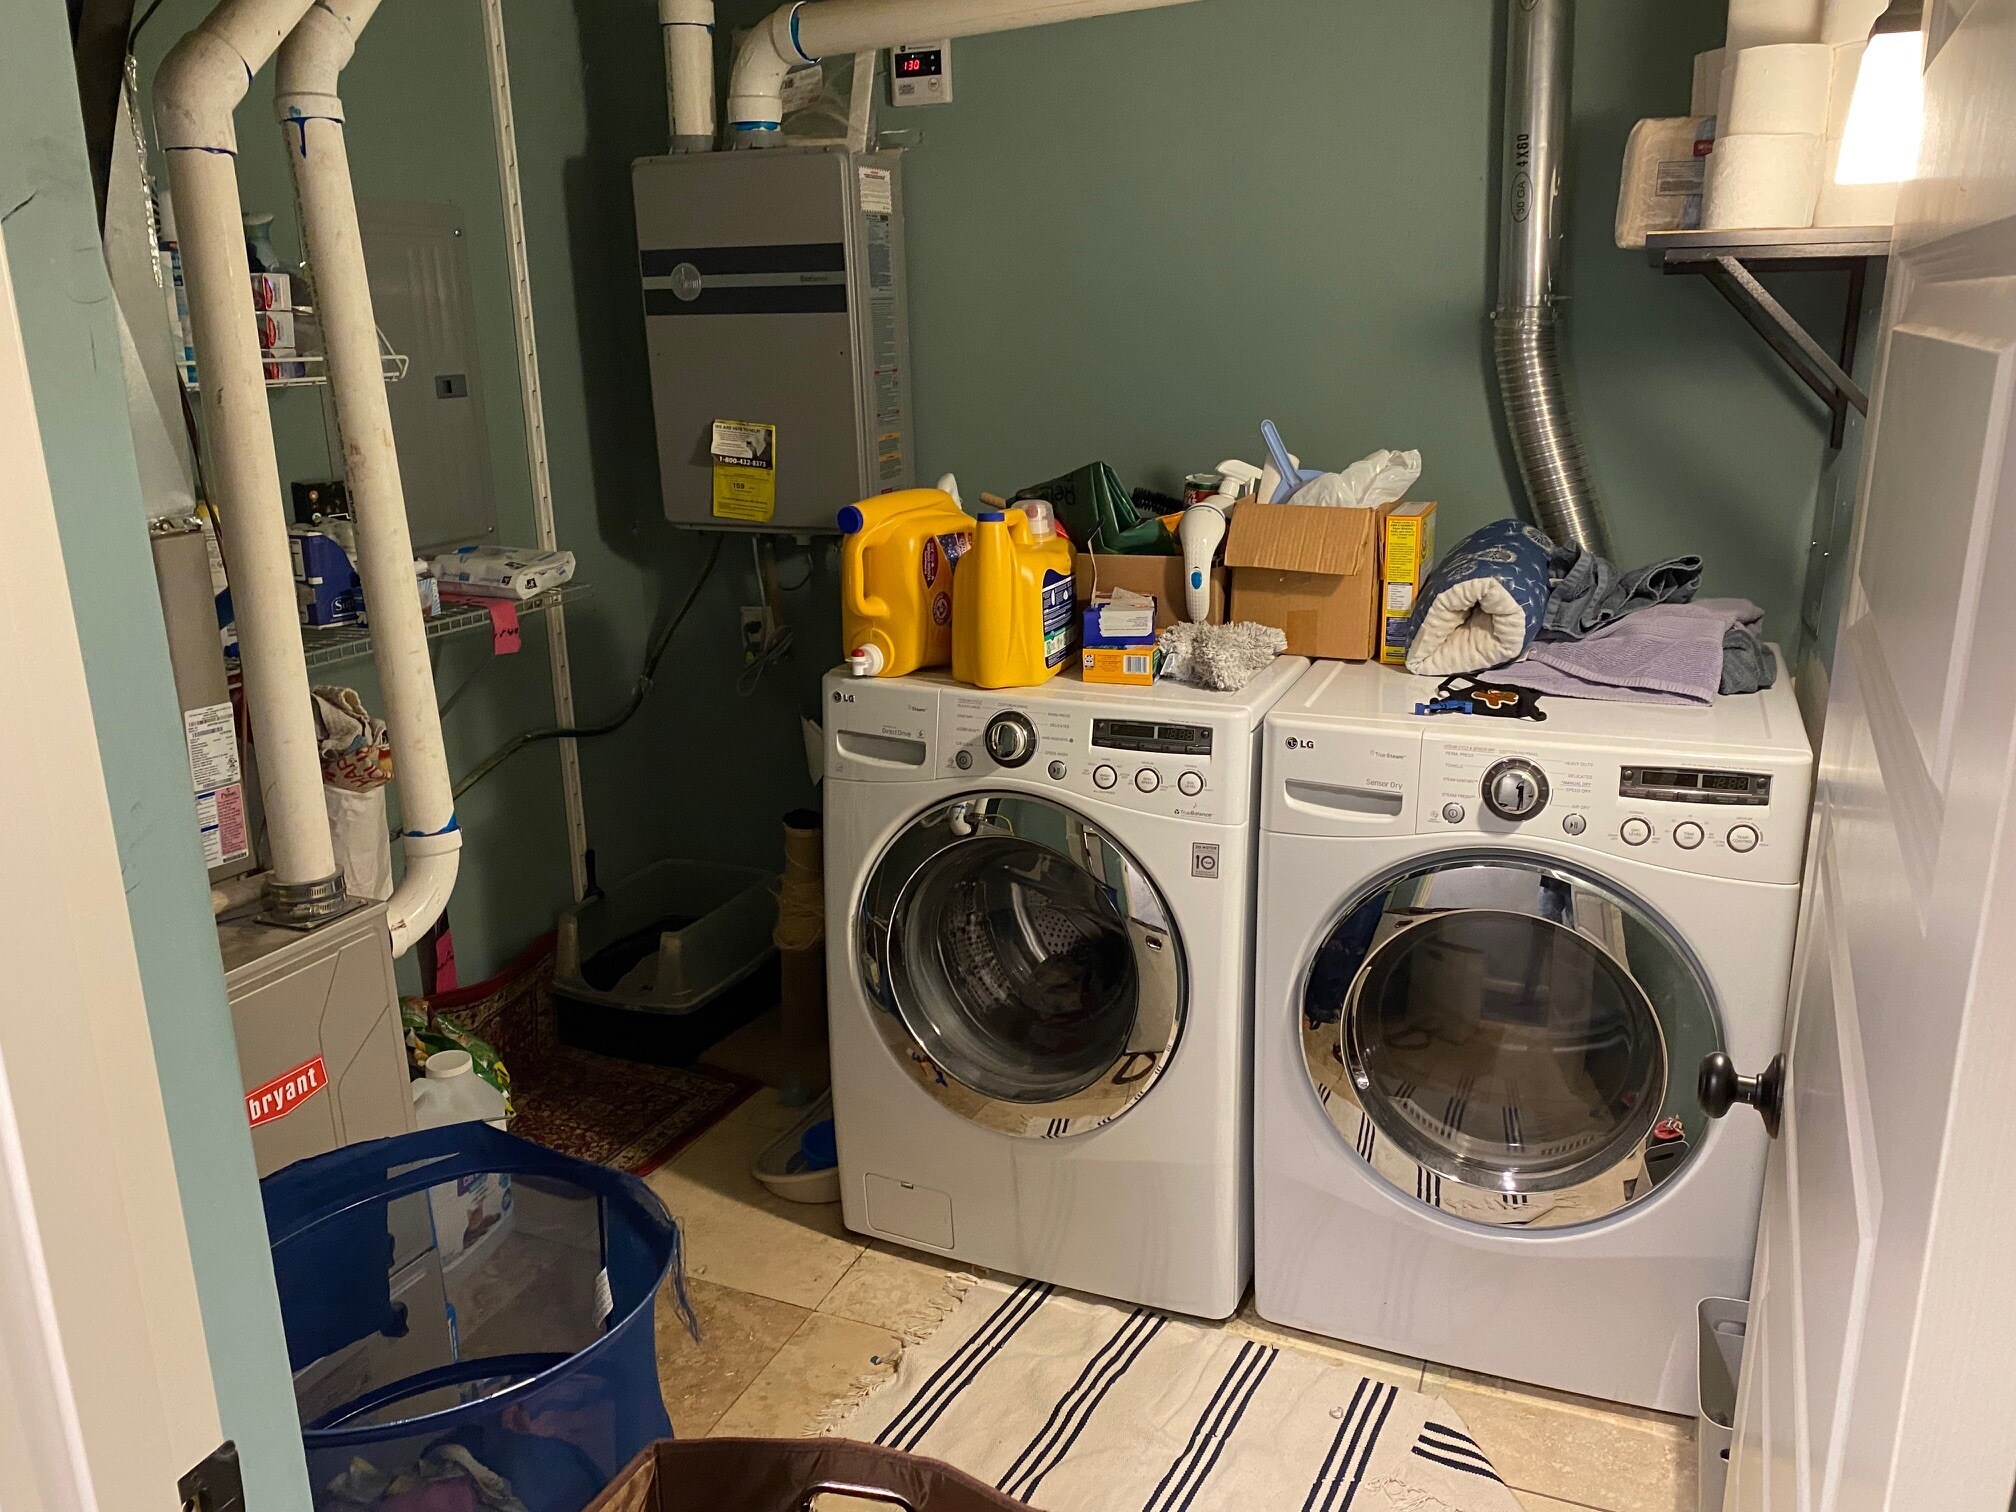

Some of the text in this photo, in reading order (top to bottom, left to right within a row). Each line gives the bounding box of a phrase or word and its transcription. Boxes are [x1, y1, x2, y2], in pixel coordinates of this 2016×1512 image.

[904, 60, 920, 70] 130
[843, 694, 854, 702] LG
[882, 728, 912, 738] Direct Drive
[1300, 740, 1314, 749] LG
[1366, 779, 1403, 790] Sensor Dry
[1196, 855, 1216, 870] 10
[248, 1067, 318, 1121] bryant
